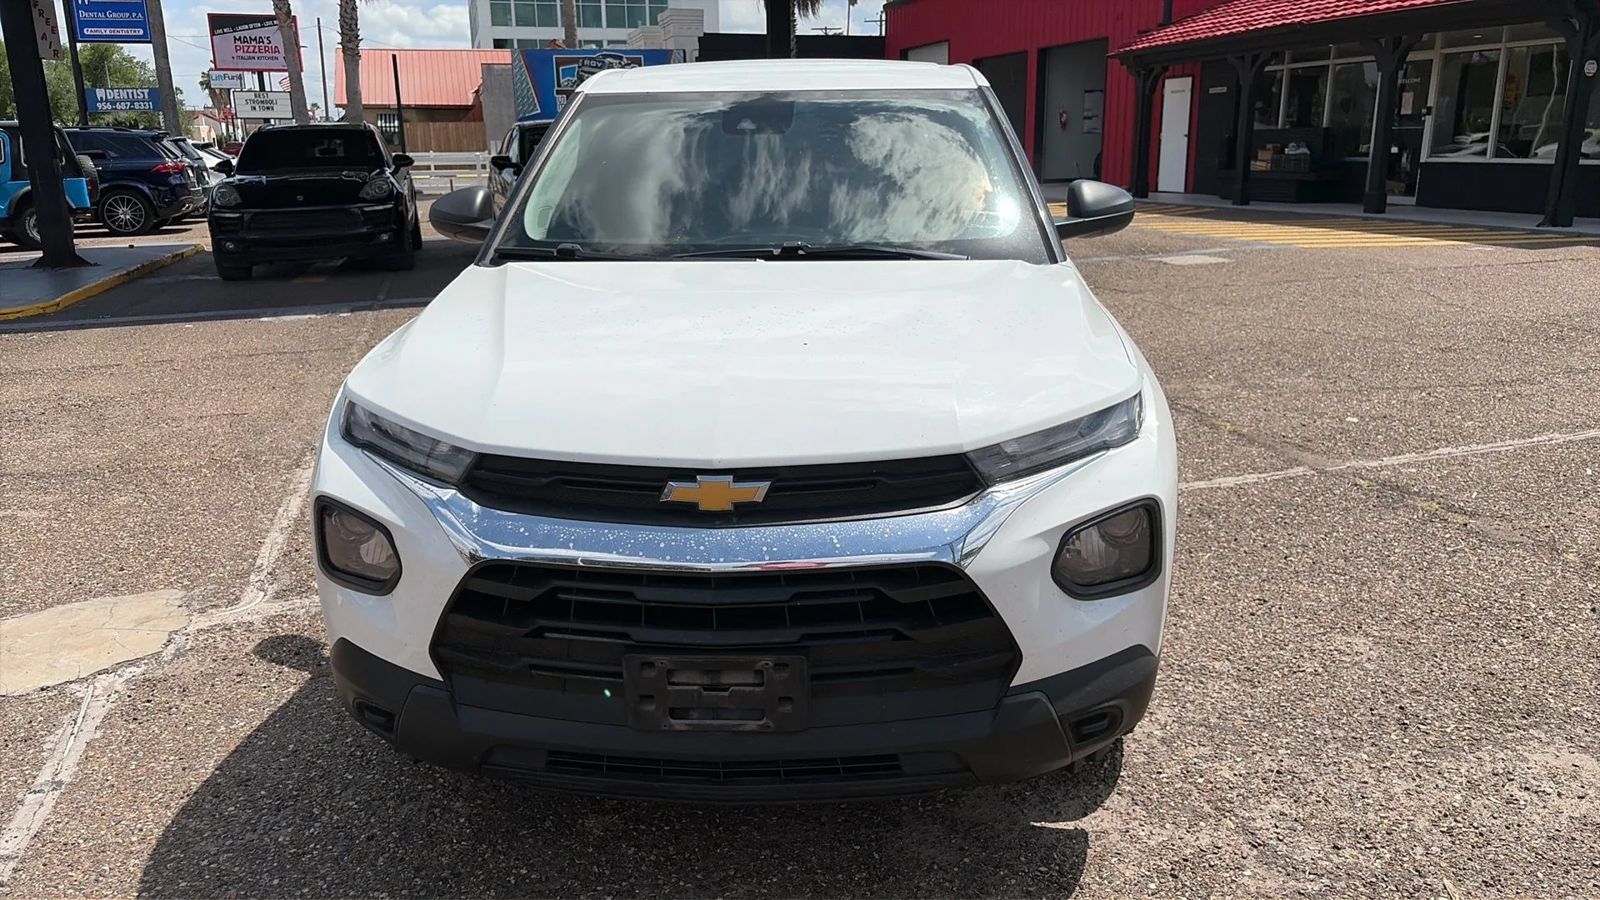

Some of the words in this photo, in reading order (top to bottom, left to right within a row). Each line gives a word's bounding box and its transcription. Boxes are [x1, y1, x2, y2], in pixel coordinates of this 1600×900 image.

[79, 10, 105, 18] DENTAL
[233, 35, 272, 45] MAMA'S
[235, 44, 280, 54] PIZZERIA
[106, 89, 149, 99] DENTIST
